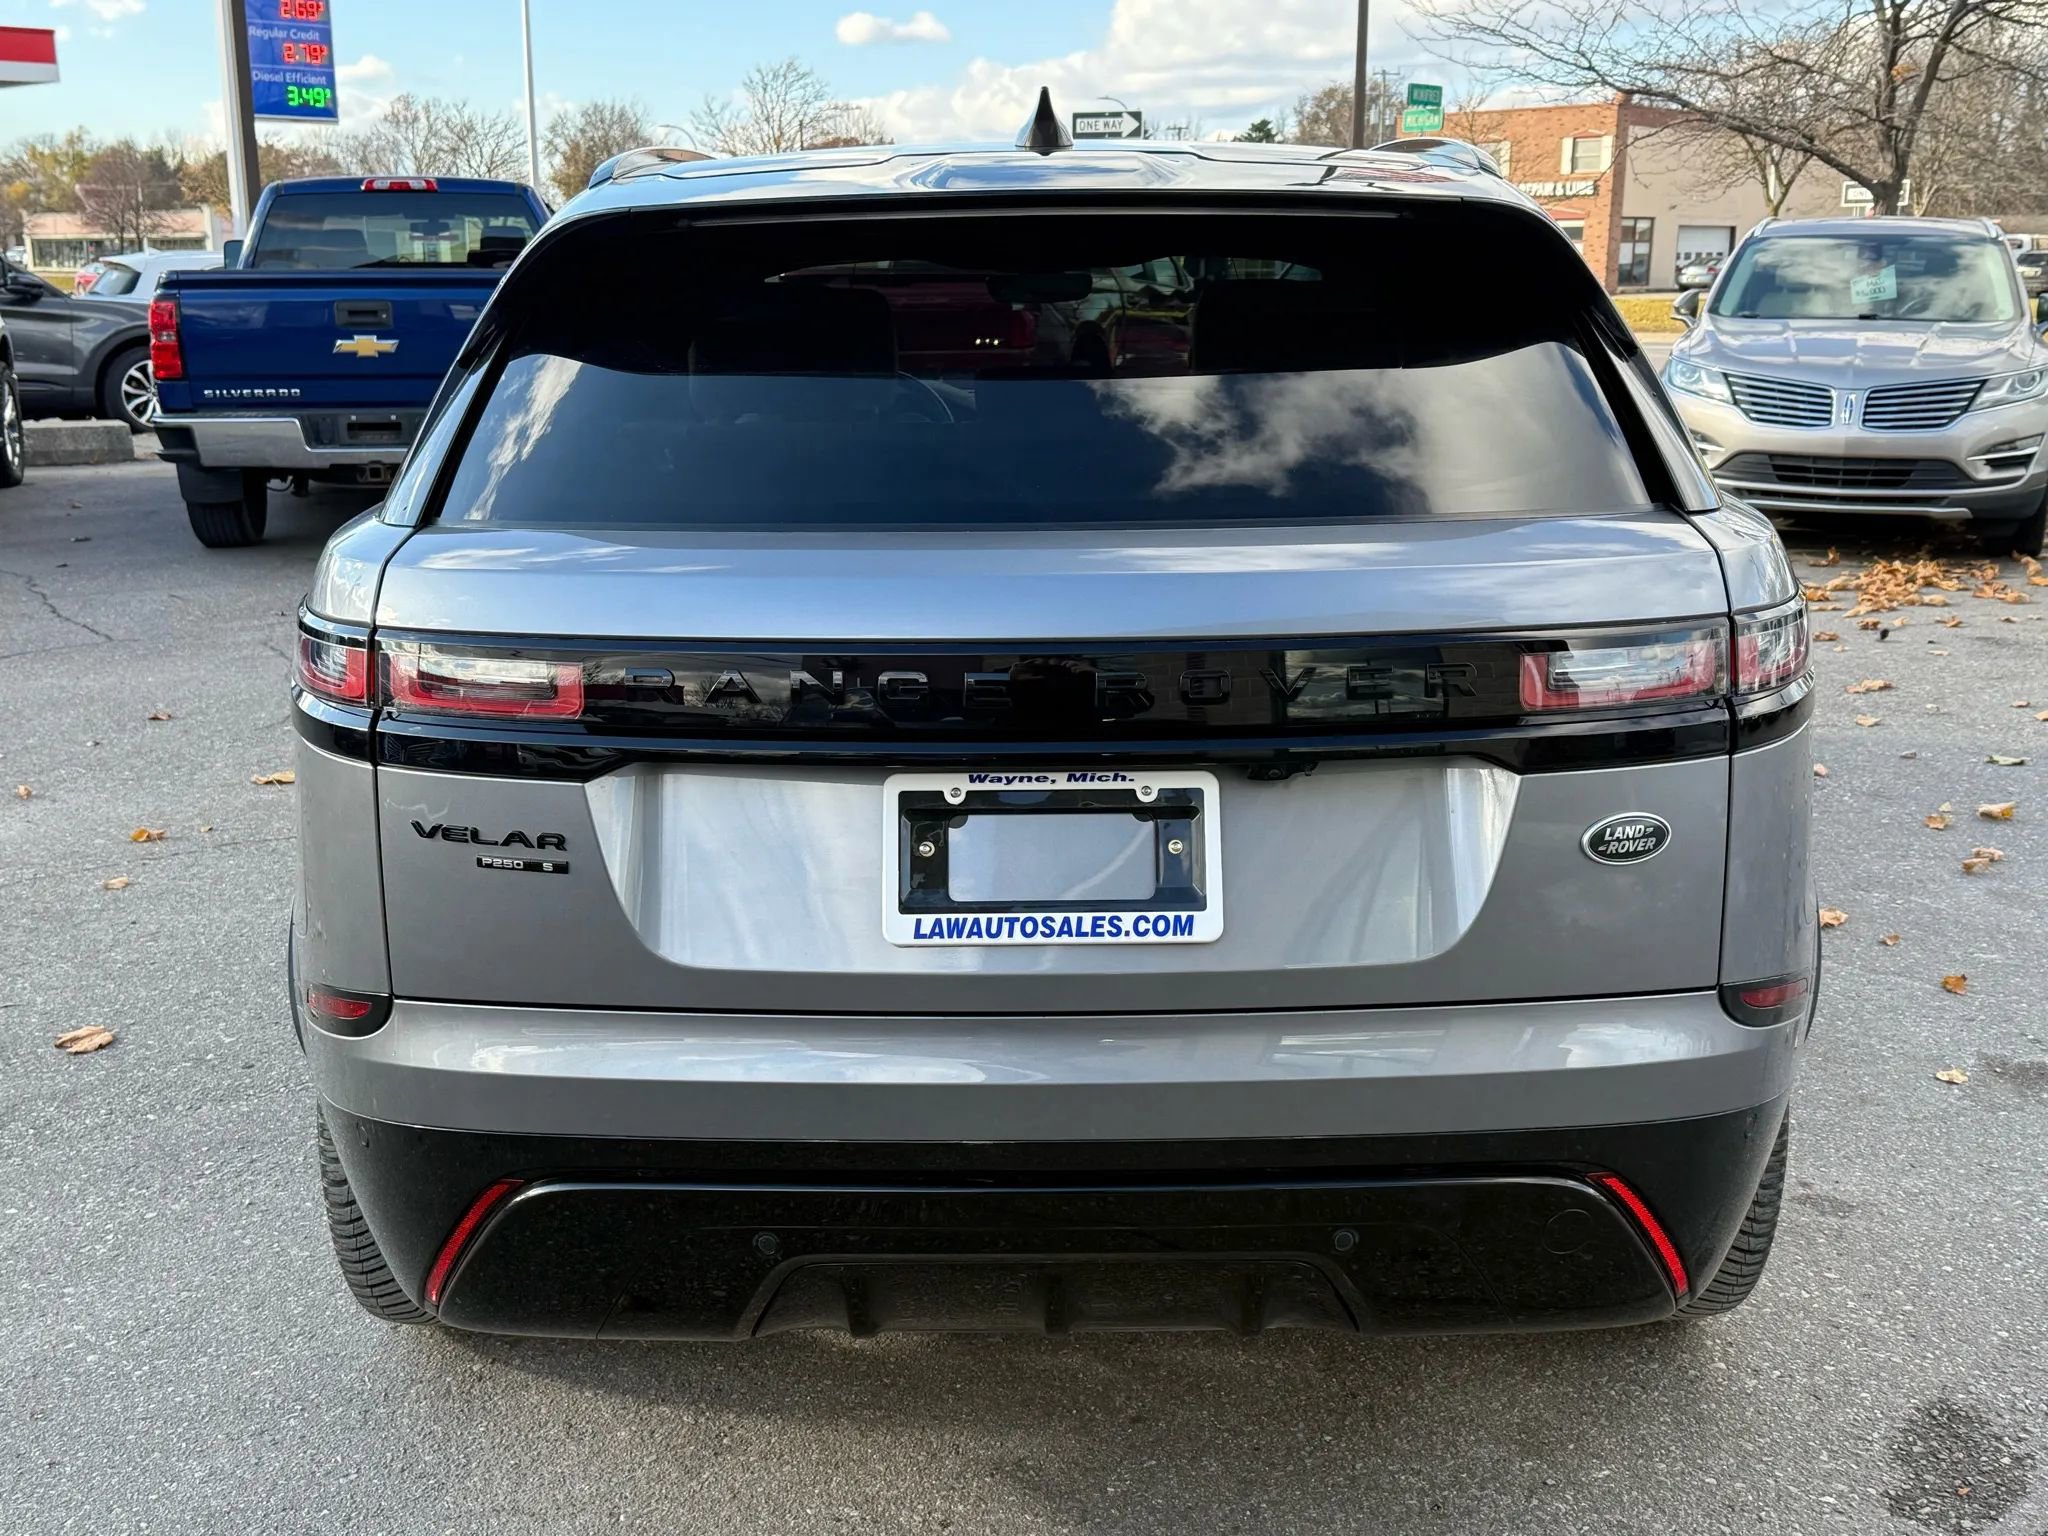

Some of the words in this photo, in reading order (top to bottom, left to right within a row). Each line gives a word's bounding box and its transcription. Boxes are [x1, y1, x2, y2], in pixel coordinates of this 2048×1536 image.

[248, 25, 287, 40] Regular
[289, 28, 320, 40] Credit
[252, 70, 283, 82] Diesel
[285, 72, 327, 84] Efficient
[1079, 120, 1100, 131] ONE
[1103, 120, 1124, 130] WAY
[204, 388, 300, 398] SILVERADO
[623, 667, 1013, 708] RANGE
[1095, 663, 1478, 709] ROVER
[968, 773, 1056, 785] Wayne,
[1066, 772, 1135, 783] Mich.
[409, 819, 568, 851] VELAR
[1604, 824, 1645, 841] LAND
[1606, 837, 1656, 854] ROVER
[481, 858, 524, 869] P250
[542, 863, 553, 872] S
[913, 915, 1195, 940] LAWAUTOSALES.COM
